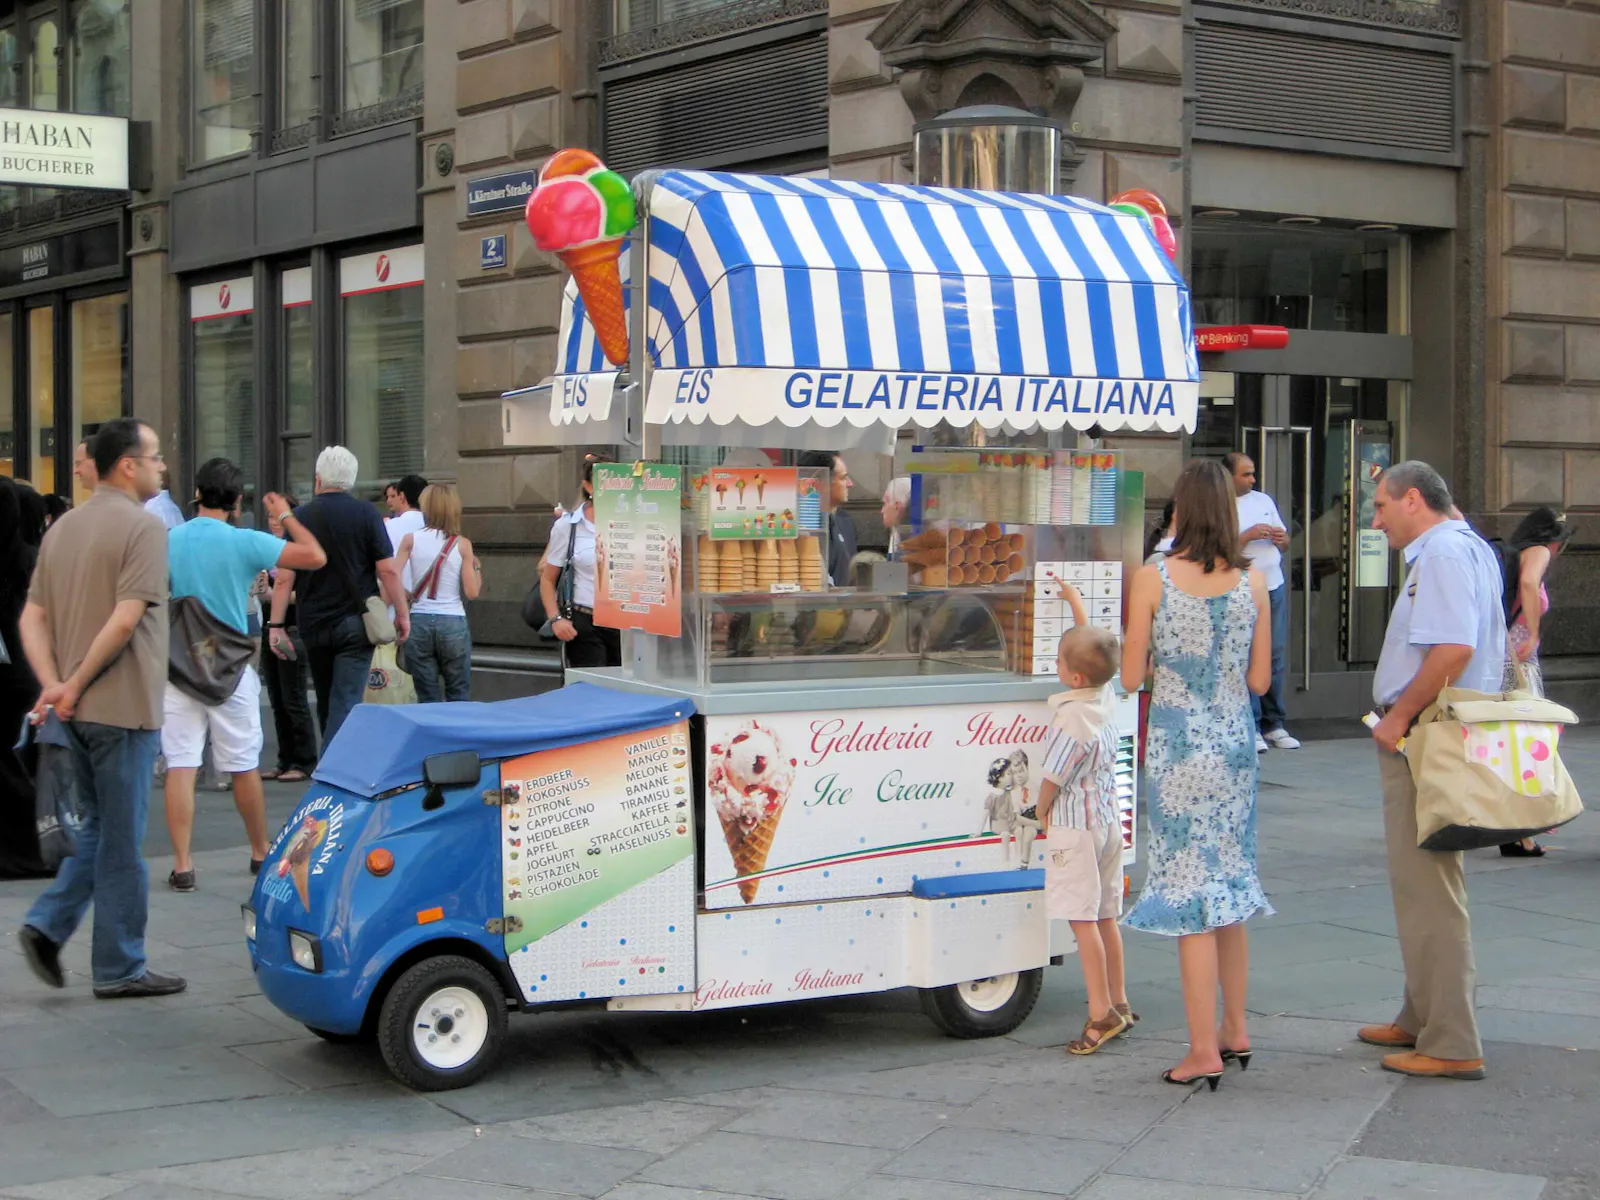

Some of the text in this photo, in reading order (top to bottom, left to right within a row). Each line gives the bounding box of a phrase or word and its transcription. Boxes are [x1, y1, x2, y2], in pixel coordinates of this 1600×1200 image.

[3, 120, 93, 149] HABAN
[2, 156, 95, 175] BUCHERER
[487, 239, 497, 257] 2
[563, 375, 589, 408] EIS
[675, 368, 713, 404] EIS
[784, 372, 1176, 416] GELATERIA ITALIANA
[625, 736, 668, 755] VANILLE
[804, 718, 932, 767] Gelateria
[628, 750, 669, 768] MANGO
[525, 769, 573, 791] ERDBEER
[626, 763, 669, 782] MELONE
[525, 778, 590, 804] KOKOSNUSS
[626, 775, 669, 796] BANANE
[804, 769, 954, 807] Ice Cream
[527, 797, 572, 818] ZITRONE
[620, 789, 670, 811] TIRAMISU
[632, 802, 670, 821] KAFFEE
[526, 803, 595, 830] CAPPUCCINO
[527, 818, 590, 844] HEIDELBEER
[590, 816, 671, 847] STRACCIATELLA
[610, 829, 671, 855] HASELNUSS
[526, 841, 558, 858] APFEL
[526, 849, 576, 871] JOGHURT
[527, 862, 580, 884] PISTAZIEN
[527, 868, 599, 898] SCHOKOLADE
[694, 968, 864, 1008] Gelateria Italiana
